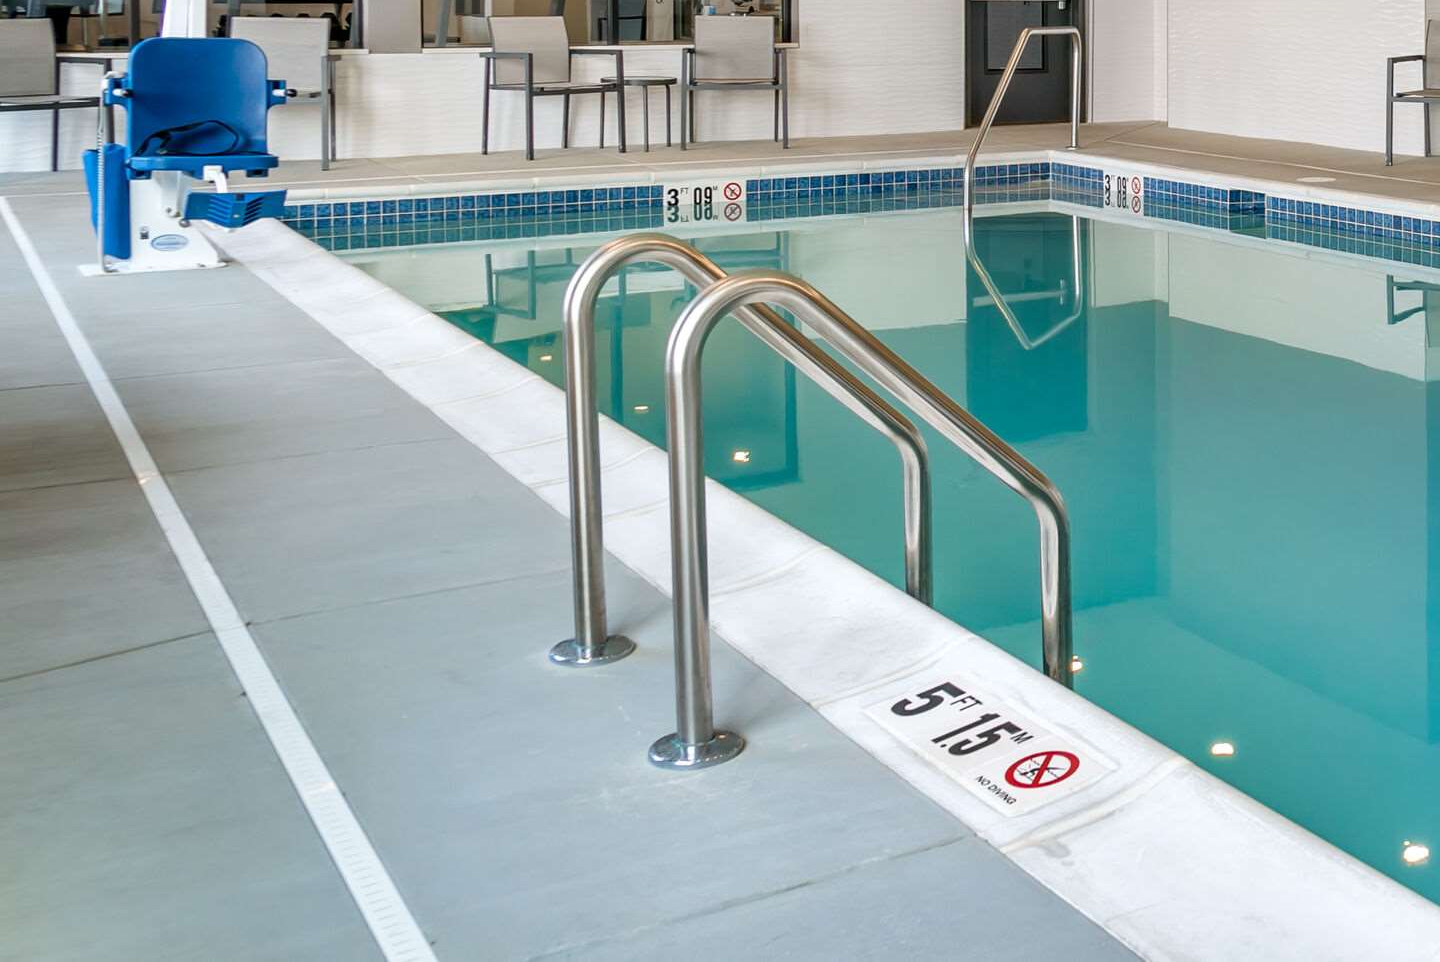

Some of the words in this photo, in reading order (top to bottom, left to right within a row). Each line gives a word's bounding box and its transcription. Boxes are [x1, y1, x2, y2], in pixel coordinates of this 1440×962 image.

[667, 189, 679, 206] 3
[891, 681, 966, 717] 5
[950, 695, 983, 711] FT
[976, 775, 991, 786] NO
[987, 784, 1017, 805] DIVING
